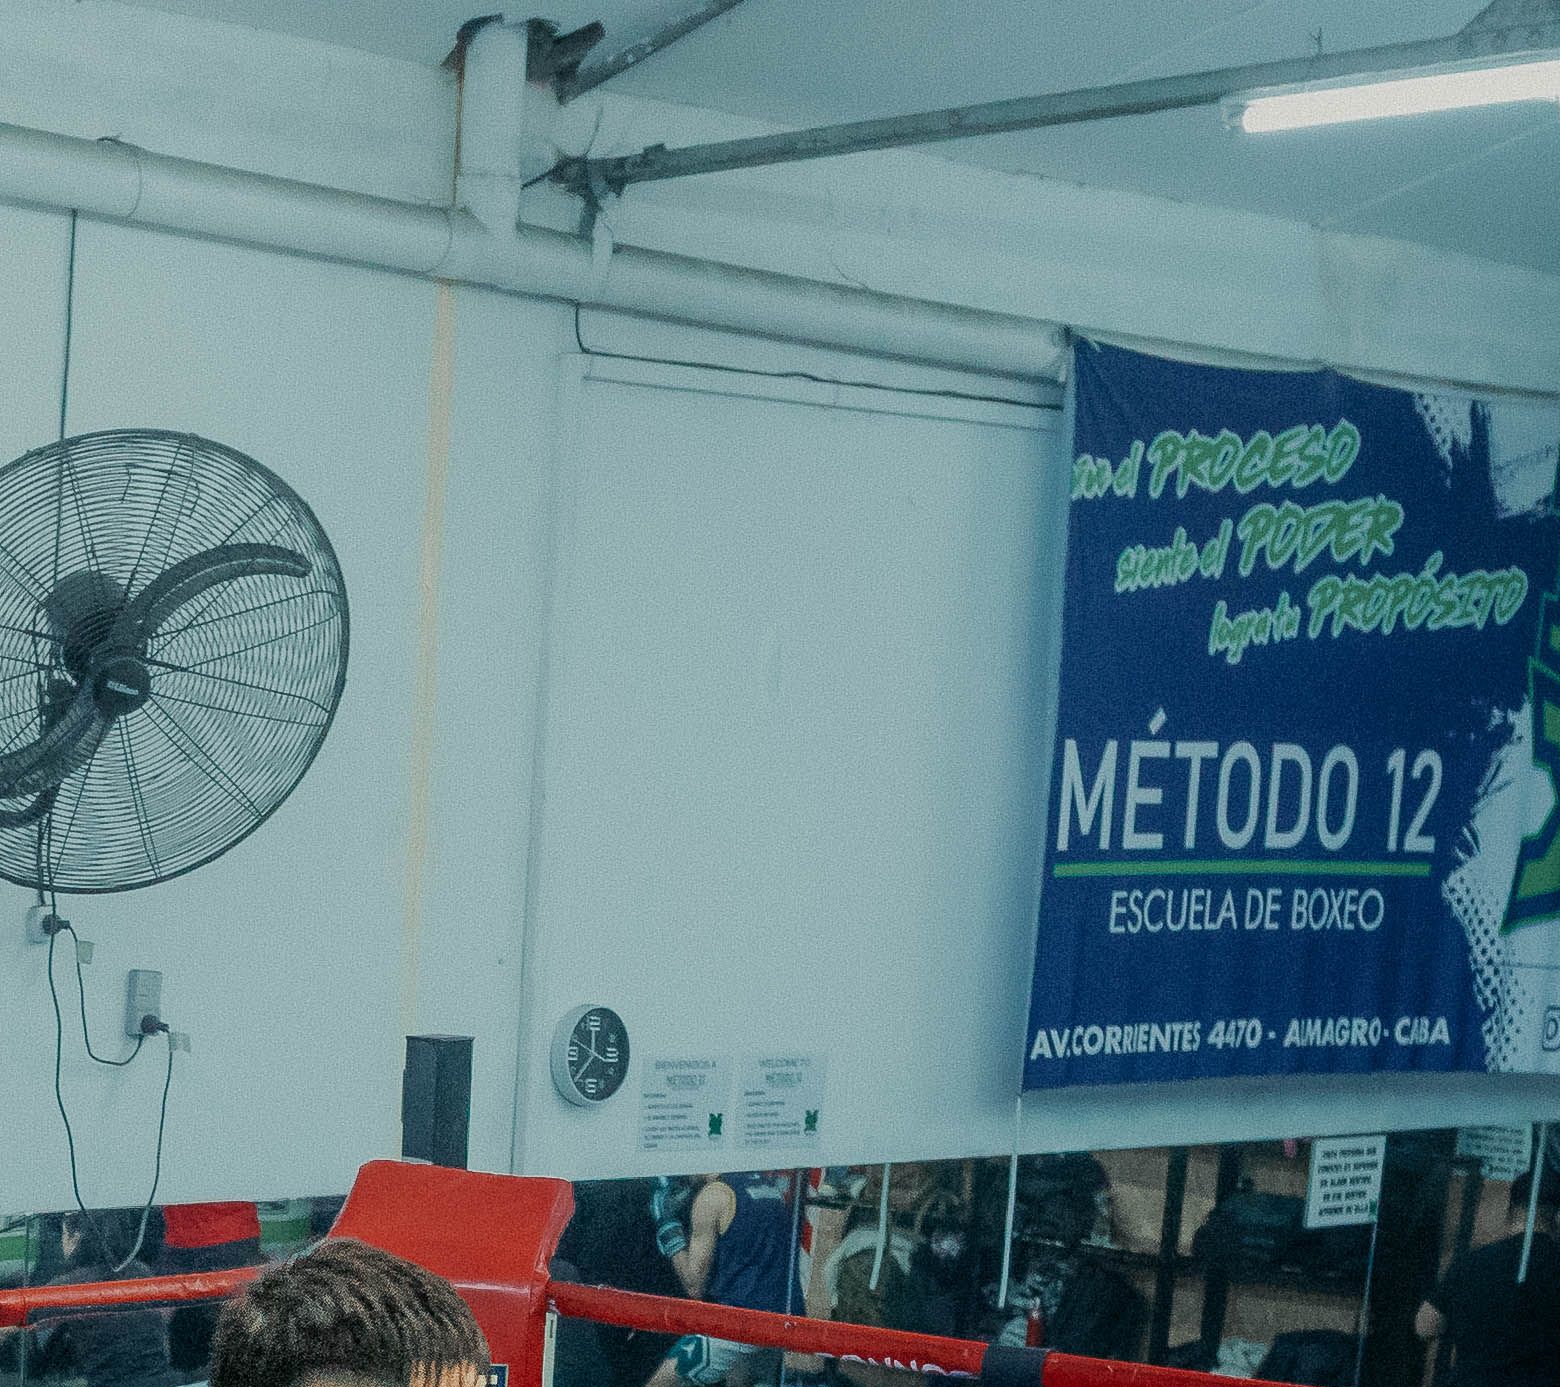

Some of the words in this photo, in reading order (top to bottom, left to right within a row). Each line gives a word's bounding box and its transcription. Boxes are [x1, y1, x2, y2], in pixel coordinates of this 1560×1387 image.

[1147, 417, 1361, 499] PROCESO
[1238, 493, 1404, 577] PODER
[1307, 550, 1528, 639] PROPÓSITO
[1056, 708, 1359, 853] MÉTODO
[1386, 749, 1444, 855] 12
[1110, 886, 1238, 933] ESCUELA
[1245, 888, 1281, 931] DE
[1291, 887, 1385, 933] BOXEO
[1207, 1017, 1262, 1049] 4470
